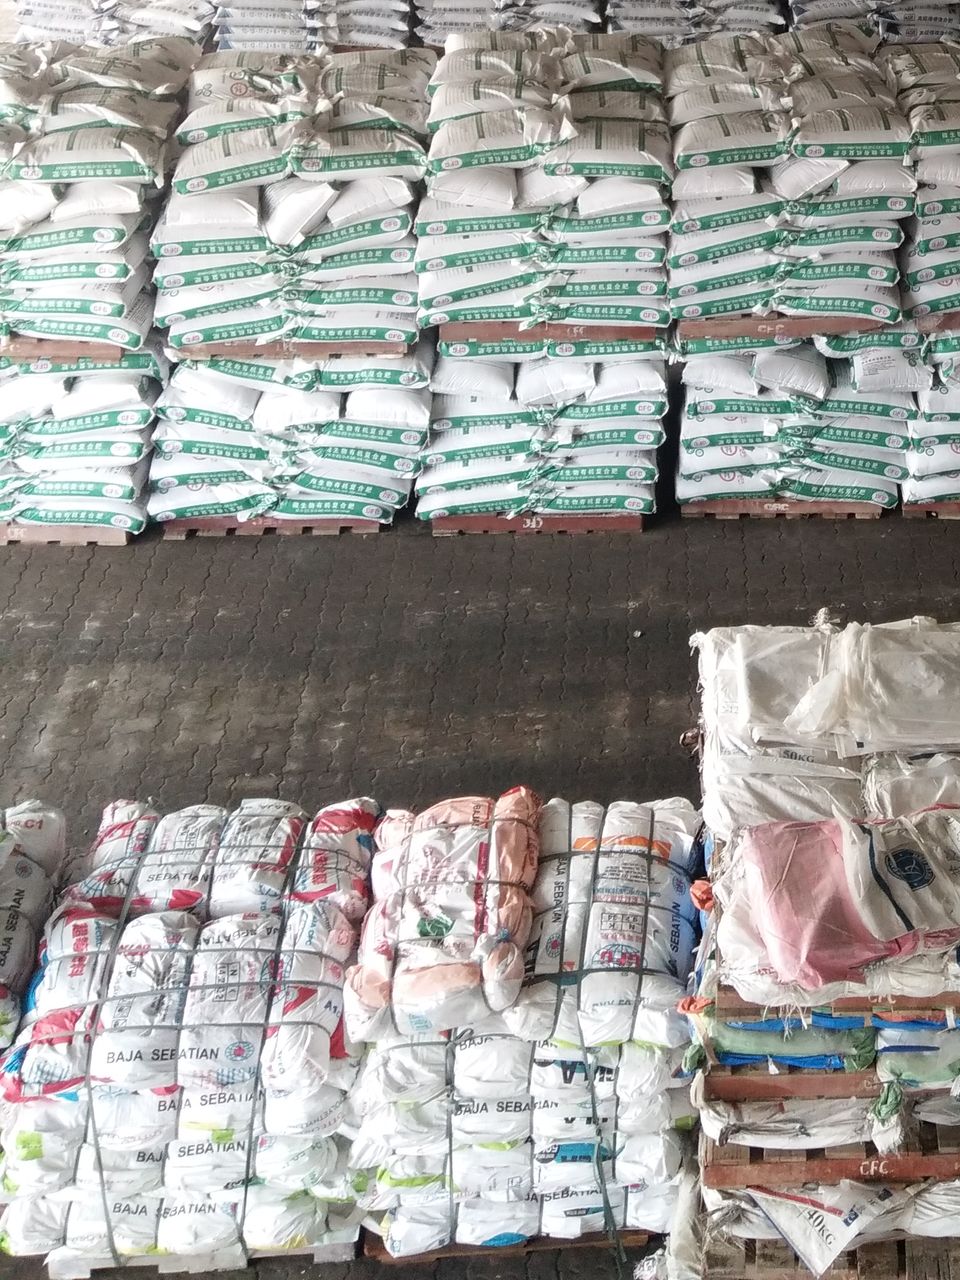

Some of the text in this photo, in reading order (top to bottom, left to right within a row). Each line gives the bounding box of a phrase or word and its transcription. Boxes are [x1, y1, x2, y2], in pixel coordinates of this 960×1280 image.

[25, 820, 43, 830] C1
[106, 1047, 220, 1064] BAJA SEBATIAN
[178, 1140, 246, 1158] SEBATIAN
[860, 1160, 890, 1176] CFC
[112, 1202, 148, 1217] BAJA
[804, 1206, 837, 1248] 40KG
